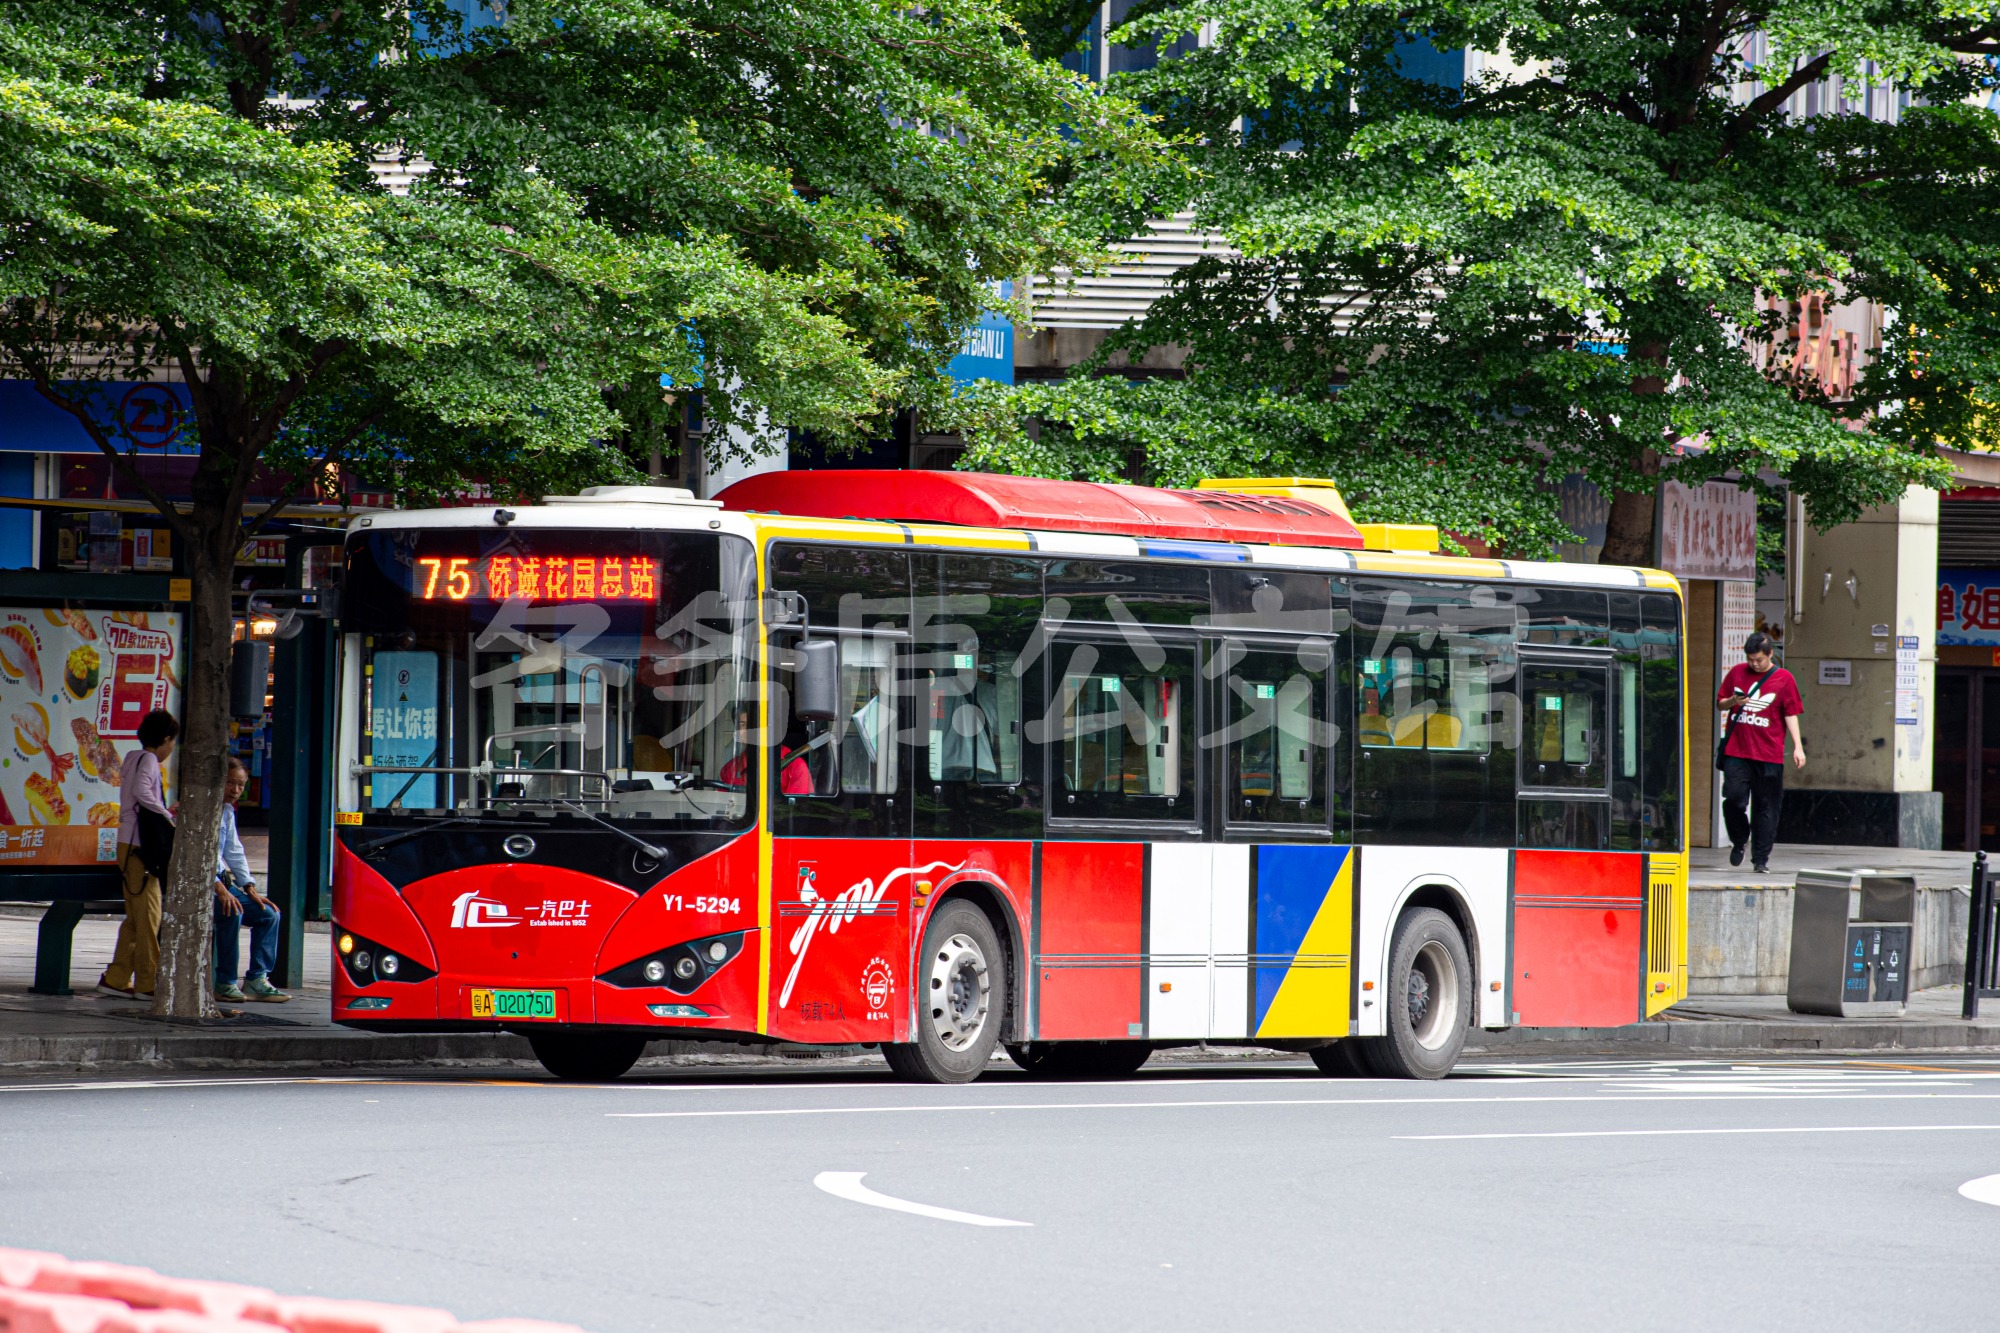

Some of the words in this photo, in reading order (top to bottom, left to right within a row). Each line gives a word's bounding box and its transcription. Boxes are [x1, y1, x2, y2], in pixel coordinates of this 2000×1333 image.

[419, 558, 471, 600] 75
[488, 557, 655, 600] 侨诚花园总站
[99, 684, 111, 730] 会员价
[524, 899, 592, 918] 一汽巴士
[662, 893, 741, 915] Y1-5294
[529, 919, 565, 927] Estabished
